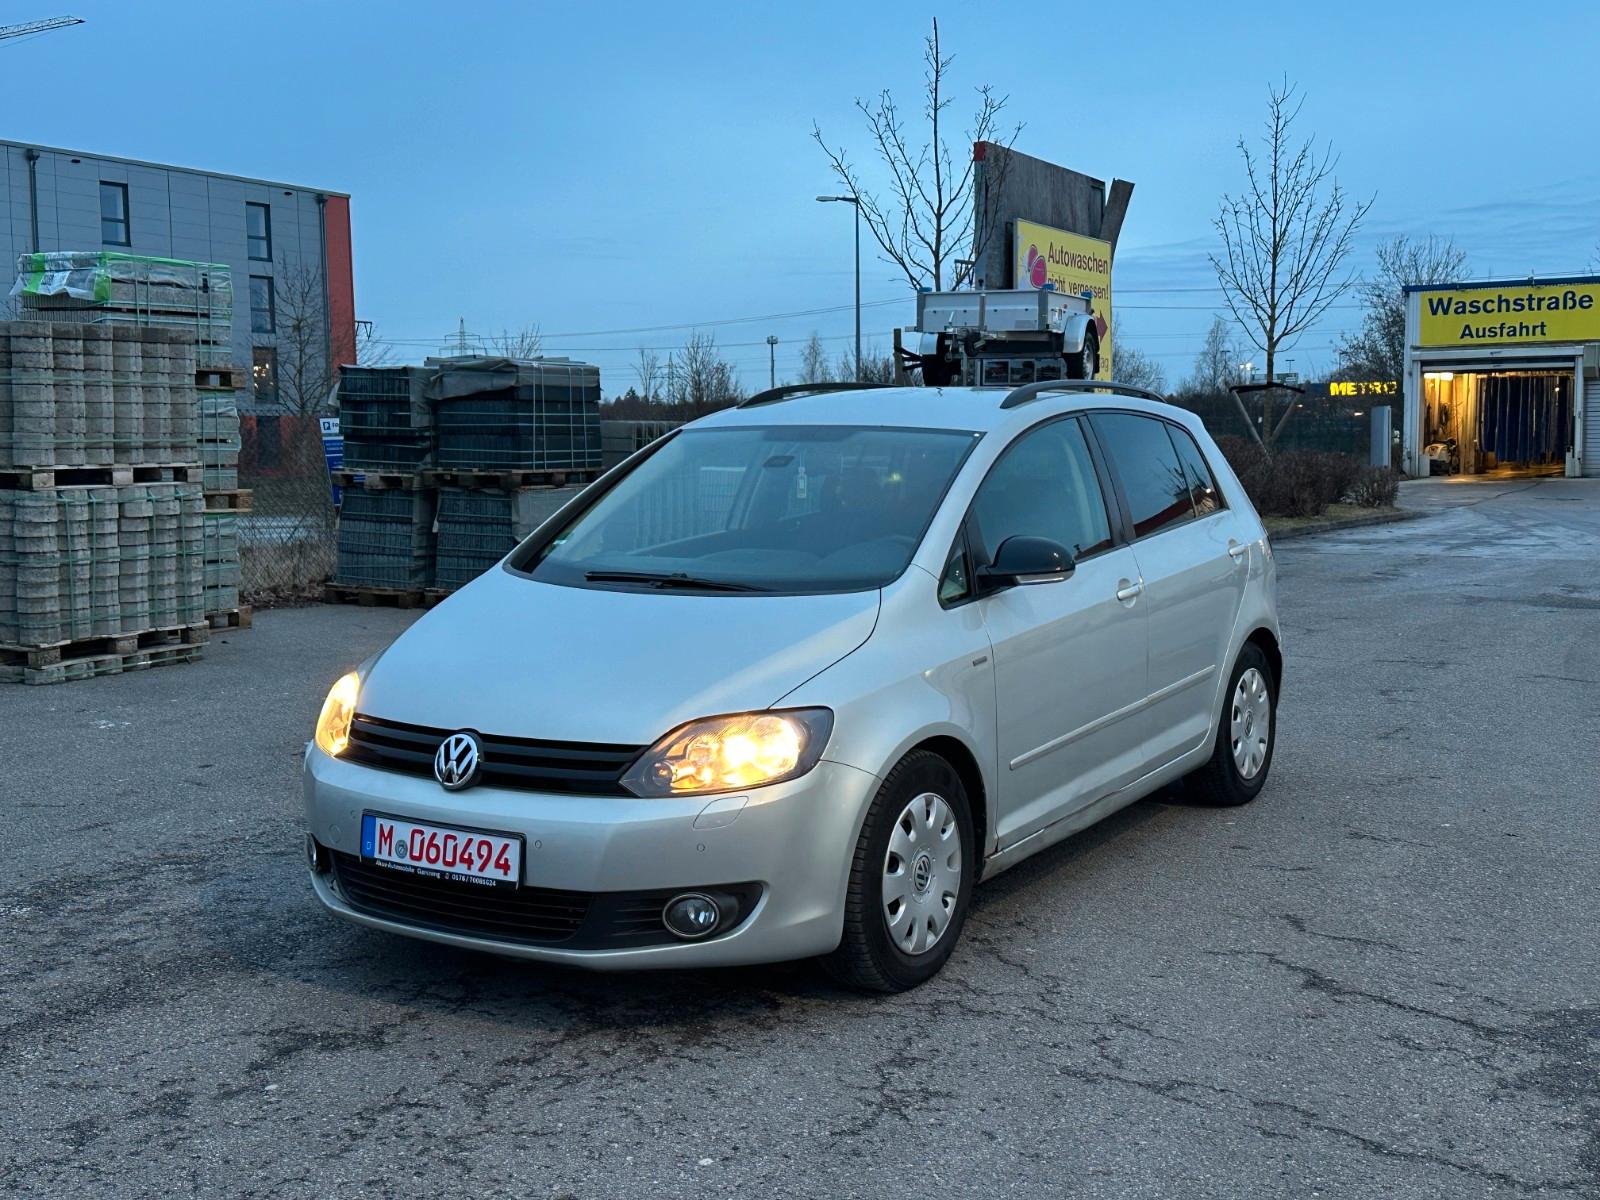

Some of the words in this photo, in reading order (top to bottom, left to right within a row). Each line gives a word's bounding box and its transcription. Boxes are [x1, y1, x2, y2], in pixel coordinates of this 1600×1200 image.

[1047, 241, 1109, 275] Autowaschen
[1428, 290, 1594, 316] Waschstraße
[1460, 321, 1547, 339] Ausfahrt
[378, 822, 394, 857] M
[408, 827, 511, 876] 060494
